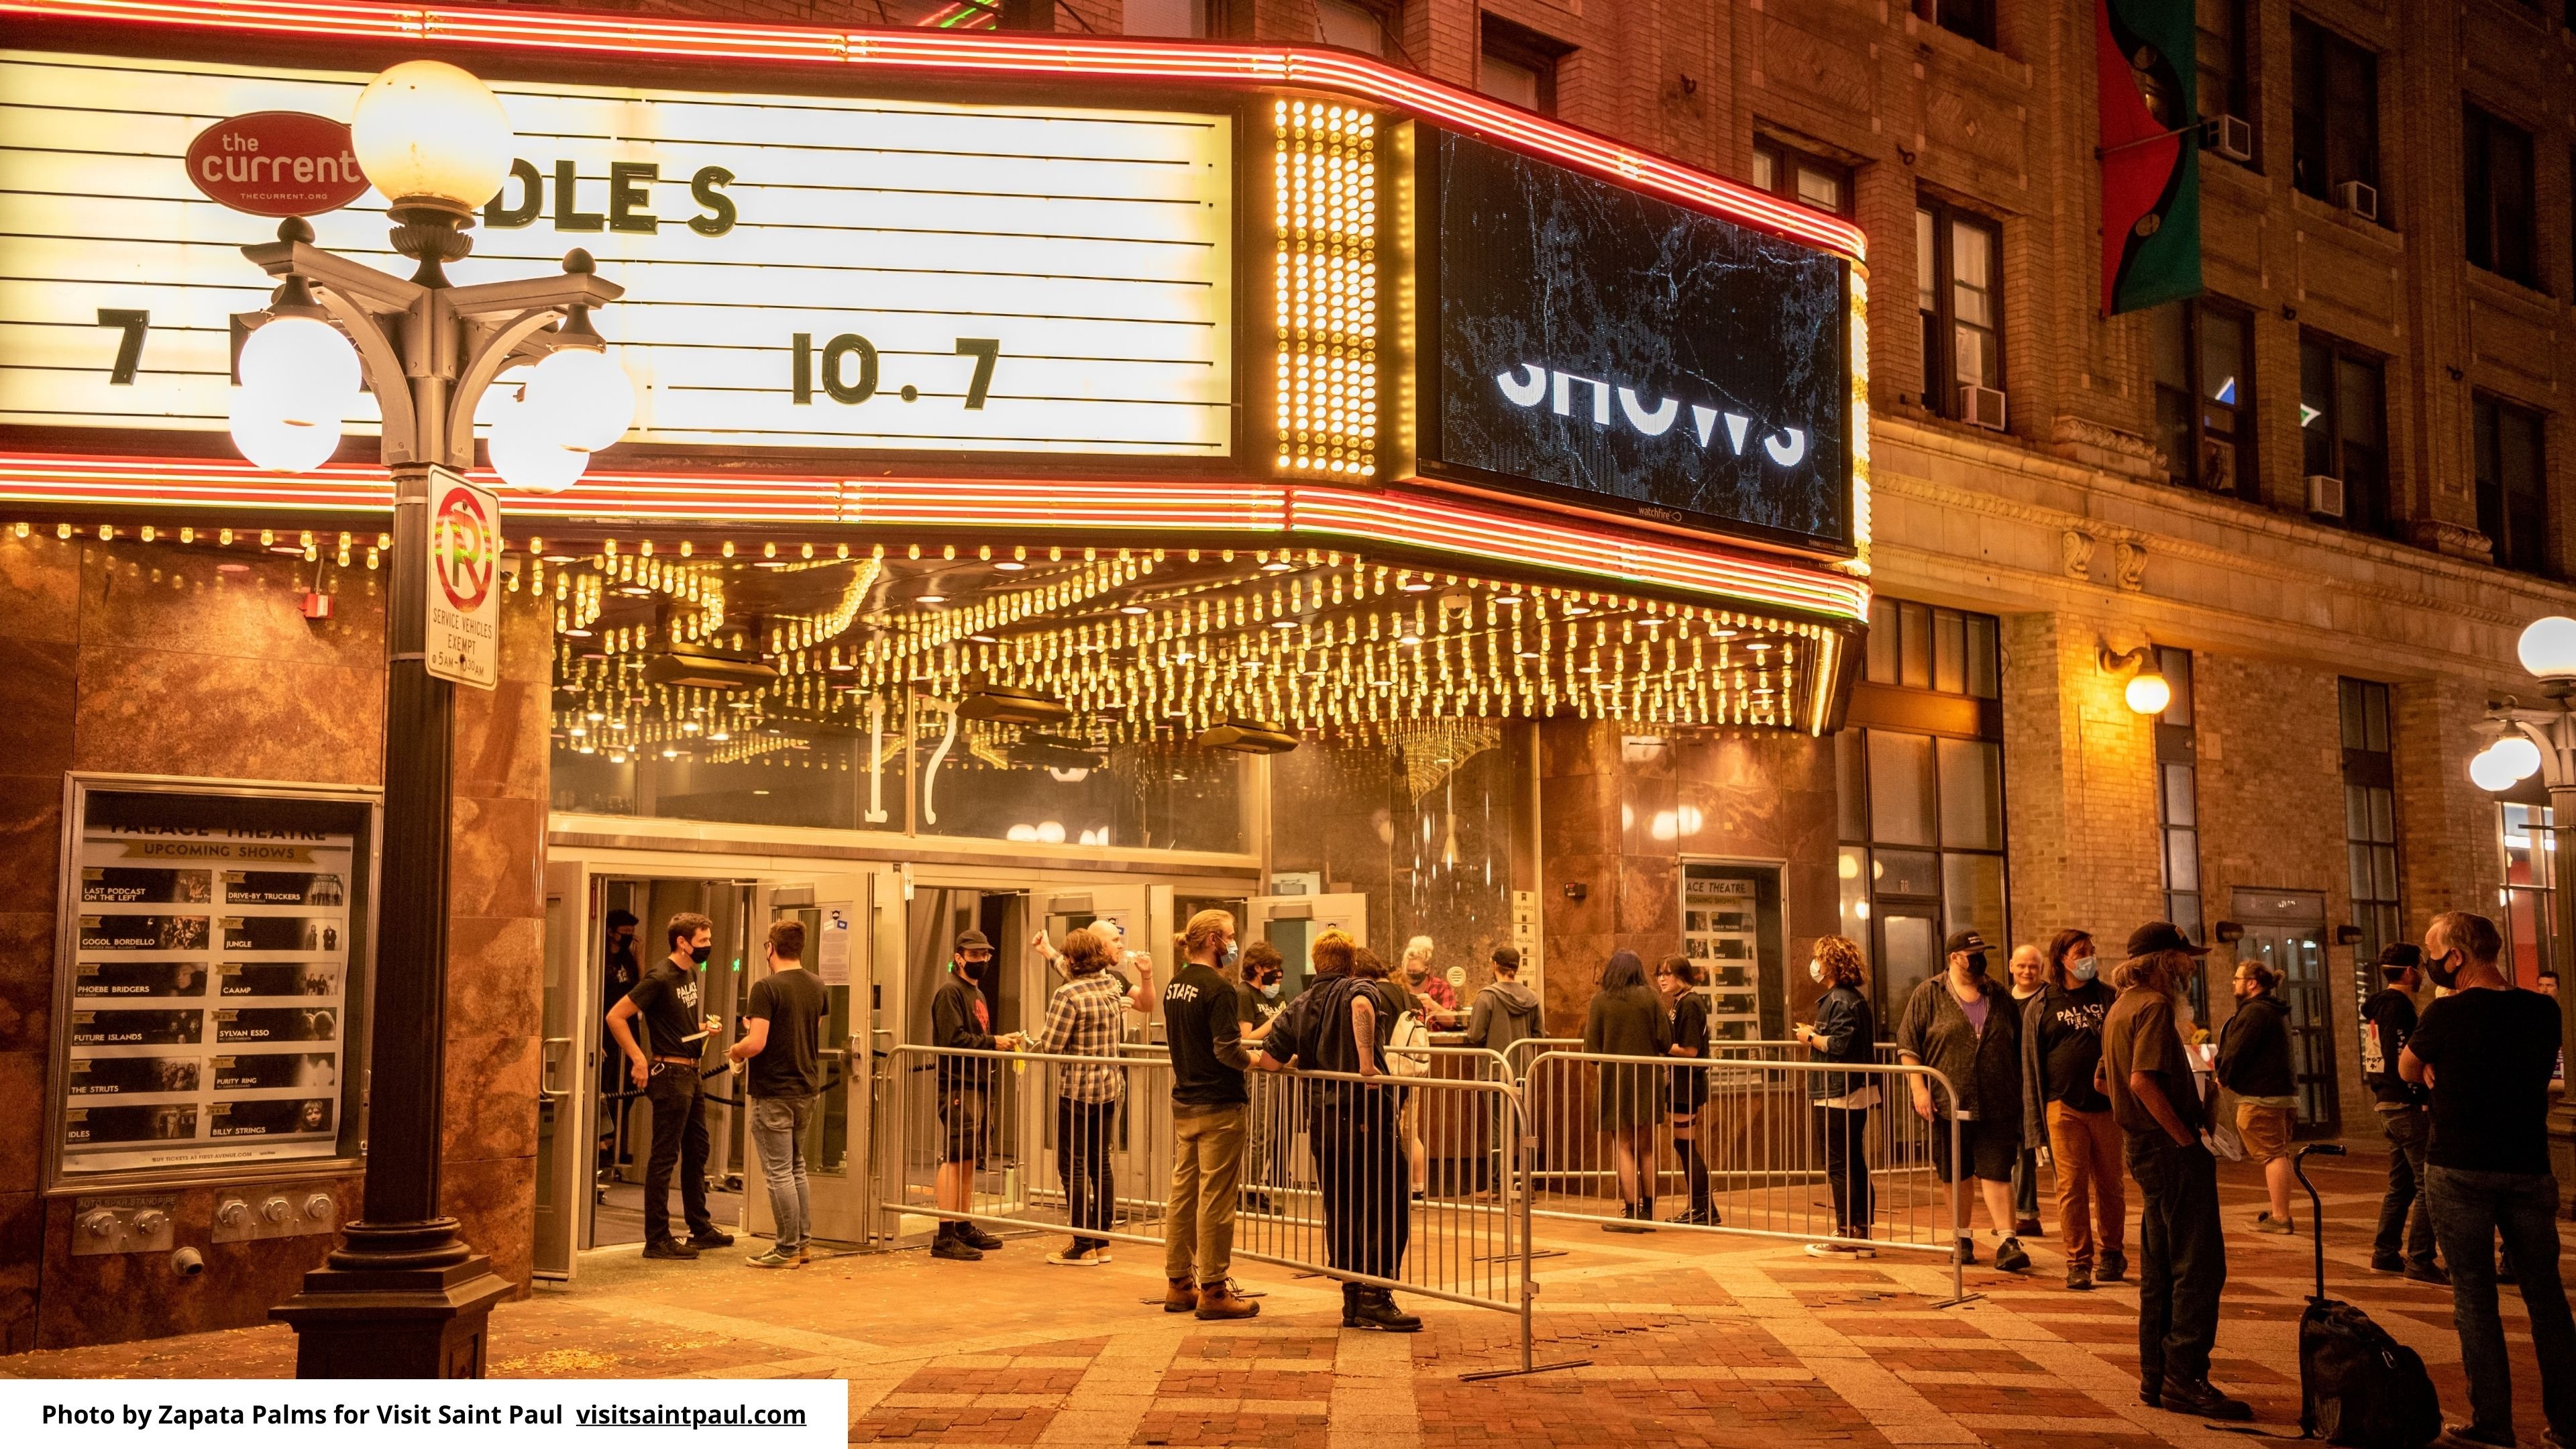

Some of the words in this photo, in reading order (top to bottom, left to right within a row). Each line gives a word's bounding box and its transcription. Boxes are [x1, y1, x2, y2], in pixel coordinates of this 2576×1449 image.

[221, 132, 259, 152] the
[201, 150, 362, 183] current
[239, 193, 328, 201] THECURRENT.ORG
[97, 308, 150, 386] 7
[1638, 507, 1670, 521] watchfire
[433, 607, 460, 630] SERVICE
[462, 616, 492, 639] VEHICLES
[447, 633, 476, 655] EXEMPT
[144, 843, 230, 857] UPCOMING
[239, 847, 294, 859] SHOWS
[107, 888, 146, 896] PODCAST
[1709, 883, 1747, 894] THEATRE
[228, 892, 262, 900] DRIVE-BY
[113, 938, 155, 947] BORDELLO
[225, 941, 252, 949] JUNGLE
[111, 985, 150, 994] BRIDGERS
[1166, 983, 1199, 1002] STAFF
[74, 1034, 105, 1042] FUTURE
[217, 1077, 239, 1085] PURITY
[89, 1085, 119, 1093] STRUTS
[68, 1130, 91, 1138] IDLES
[78, 1198, 103, 1208] AUTO
[129, 1195, 177, 1207] STANDPIPE
